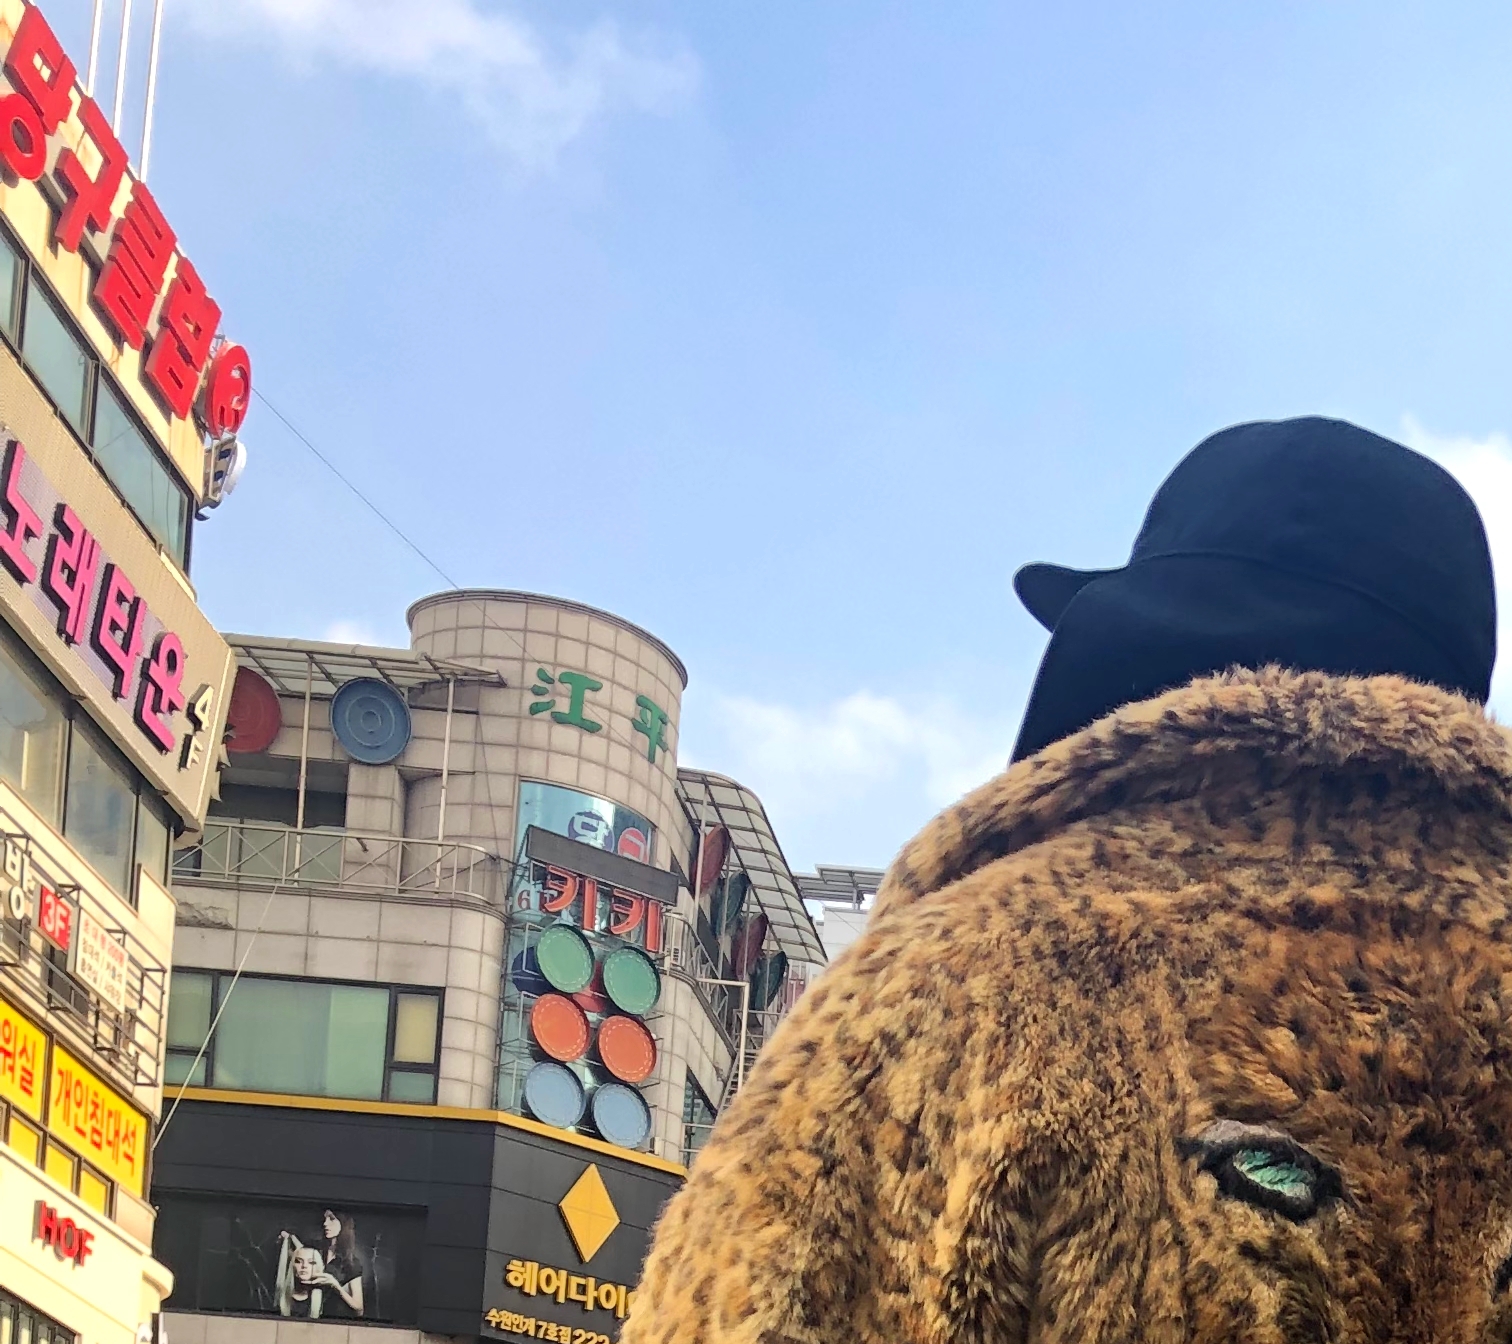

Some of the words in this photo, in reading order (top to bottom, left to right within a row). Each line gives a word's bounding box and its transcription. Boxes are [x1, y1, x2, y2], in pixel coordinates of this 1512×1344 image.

[0, 441, 185, 753] 노래타운
[43, 893, 68, 939] 3F
[545, 864, 664, 954] 키키
[55, 1068, 137, 1178] 개인침대석
[39, 1200, 96, 1267] HOF
[485, 1308, 536, 1337] 수원인계
[506, 1259, 637, 1319] 헤어다이
